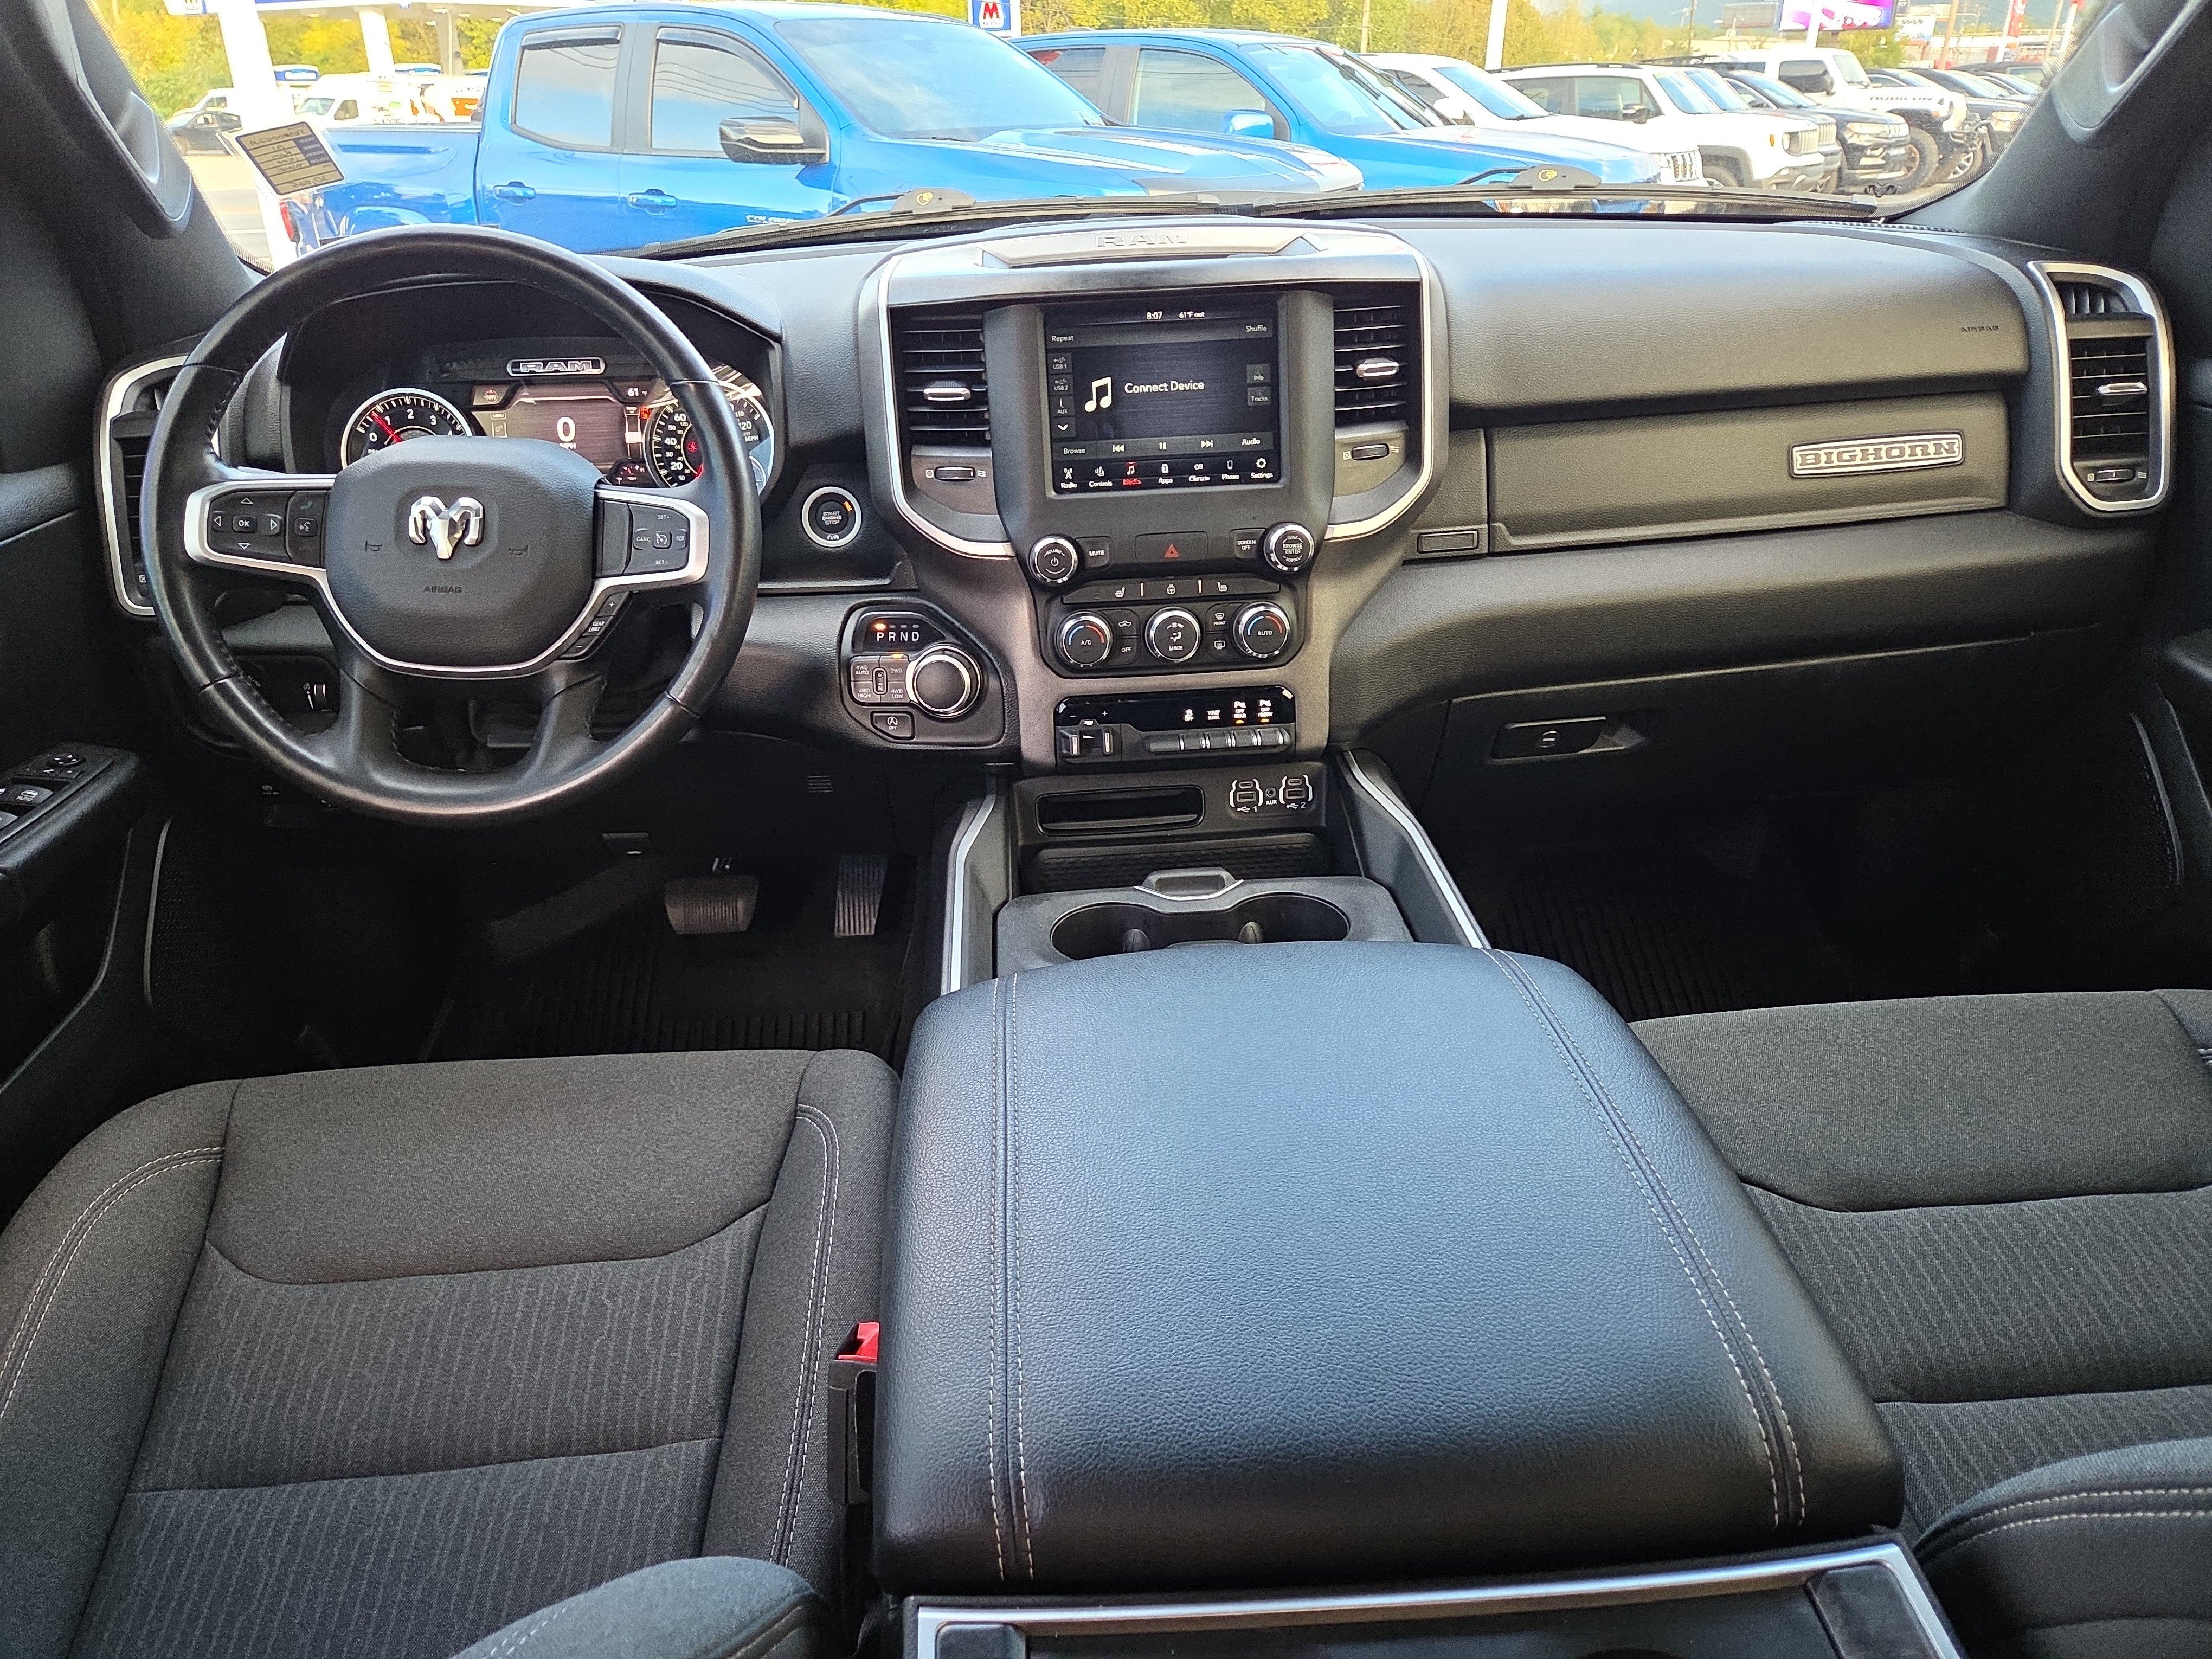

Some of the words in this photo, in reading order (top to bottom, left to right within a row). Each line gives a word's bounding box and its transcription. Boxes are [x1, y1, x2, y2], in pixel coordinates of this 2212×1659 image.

[982, 2, 1000, 20] M
[1096, 232, 1186, 247] RAM
[1146, 311, 1163, 320] 8:07
[1245, 325, 1267, 333] Shuffle
[1051, 335, 1074, 343] Repeat
[520, 361, 593, 373] RAM
[627, 387, 639, 397] 61
[1124, 382, 1168, 394] Connect
[1170, 380, 1205, 391] Device
[407, 408, 415, 419] 2
[674, 413, 686, 422] 60
[384, 415, 391, 426] 1
[429, 415, 437, 426] 3
[556, 416, 576, 442] 0
[369, 432, 377, 442] 0
[664, 437, 677, 446] 40
[1797, 440, 1958, 468] BIGHORN
[670, 461, 683, 471] 20
[423, 586, 462, 594] AIRBAG
[876, 632, 884, 642] P
[888, 632, 896, 641] R
[900, 631, 908, 641] N
[911, 631, 919, 641] D
[1253, 805, 1257, 813] 1
